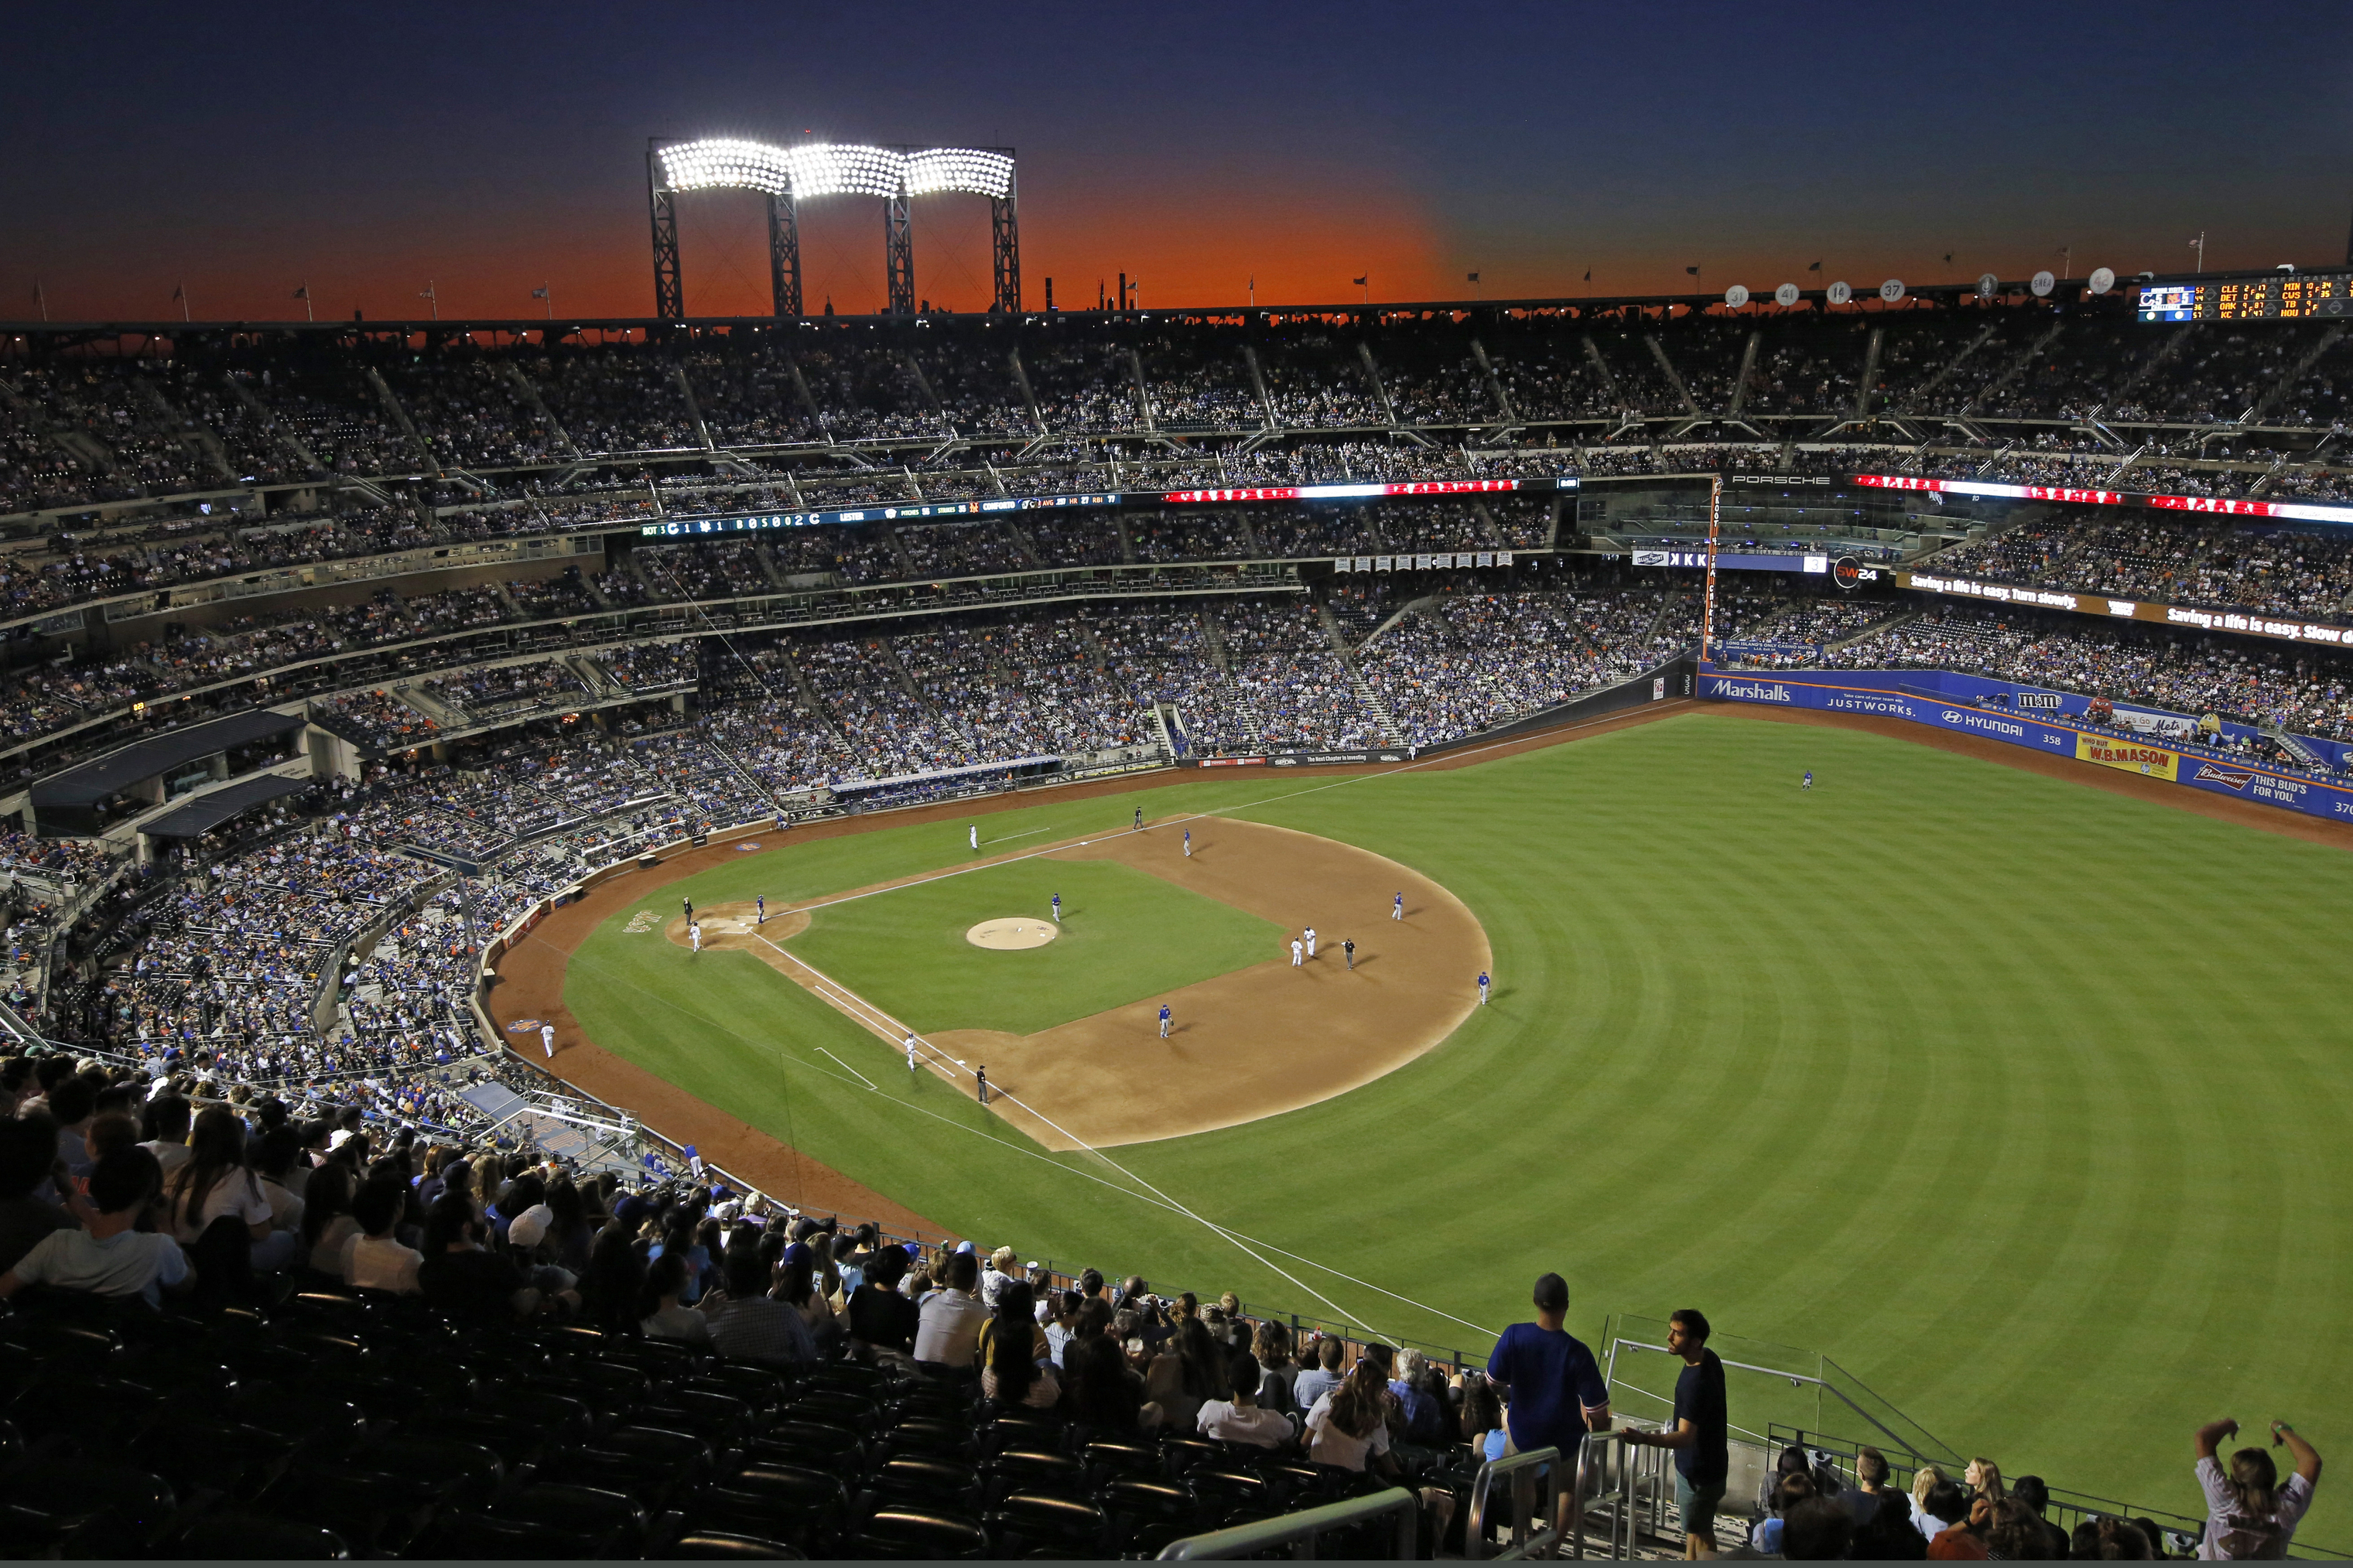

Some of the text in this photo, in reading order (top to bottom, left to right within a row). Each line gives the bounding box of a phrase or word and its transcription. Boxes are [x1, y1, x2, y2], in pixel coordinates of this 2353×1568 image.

[1884, 285, 1900, 296] 37
[2221, 285, 2238, 293] CLE
[2283, 282, 2301, 291] MIN
[1731, 292, 1743, 302] 31
[1781, 289, 1794, 299] 41
[1833, 287, 1845, 298] 14
[2220, 293, 2238, 302] DET
[2219, 302, 2236, 310] OAK
[2220, 310, 2232, 319] KC
[2280, 309, 2299, 317] HOU
[1732, 476, 1830, 484] PORSCHE
[983, 500, 1016, 511] CONFORTO
[1081, 496, 1089, 504] 27
[1107, 494, 1116, 503] 77
[736, 519, 744, 529] B
[761, 518, 768, 528] S
[795, 515, 804, 526] 2
[839, 512, 865, 522] LESTER
[642, 525, 658, 536] BOT
[1811, 559, 1819, 570] 3
[1910, 575, 1944, 593] Saving
[1952, 579, 1969, 593] life
[1971, 581, 1982, 595] is
[1982, 585, 2010, 601] easy.
[2012, 588, 2037, 603] Turn
[2037, 592, 2078, 610] slowly.
[2167, 608, 2211, 628] Saving
[2225, 614, 2247, 630] life
[2249, 617, 2263, 633] is
[2264, 621, 2301, 640] easy.
[2303, 625, 2341, 642] Slow
[1711, 679, 1790, 702] Marshalls
[1827, 698, 1917, 717] JUSTWORKS.
[1965, 716, 2023, 736] HYUNDAI
[2139, 716, 2150, 725] Go
[2043, 734, 2061, 746] 358
[2081, 737, 2095, 746] WHO
[2141, 764, 2150, 774] hp
[2200, 767, 2247, 785] Budweiser
[2255, 774, 2307, 794] THIS BUD'S
[2253, 785, 2295, 803] FOR YOU.
